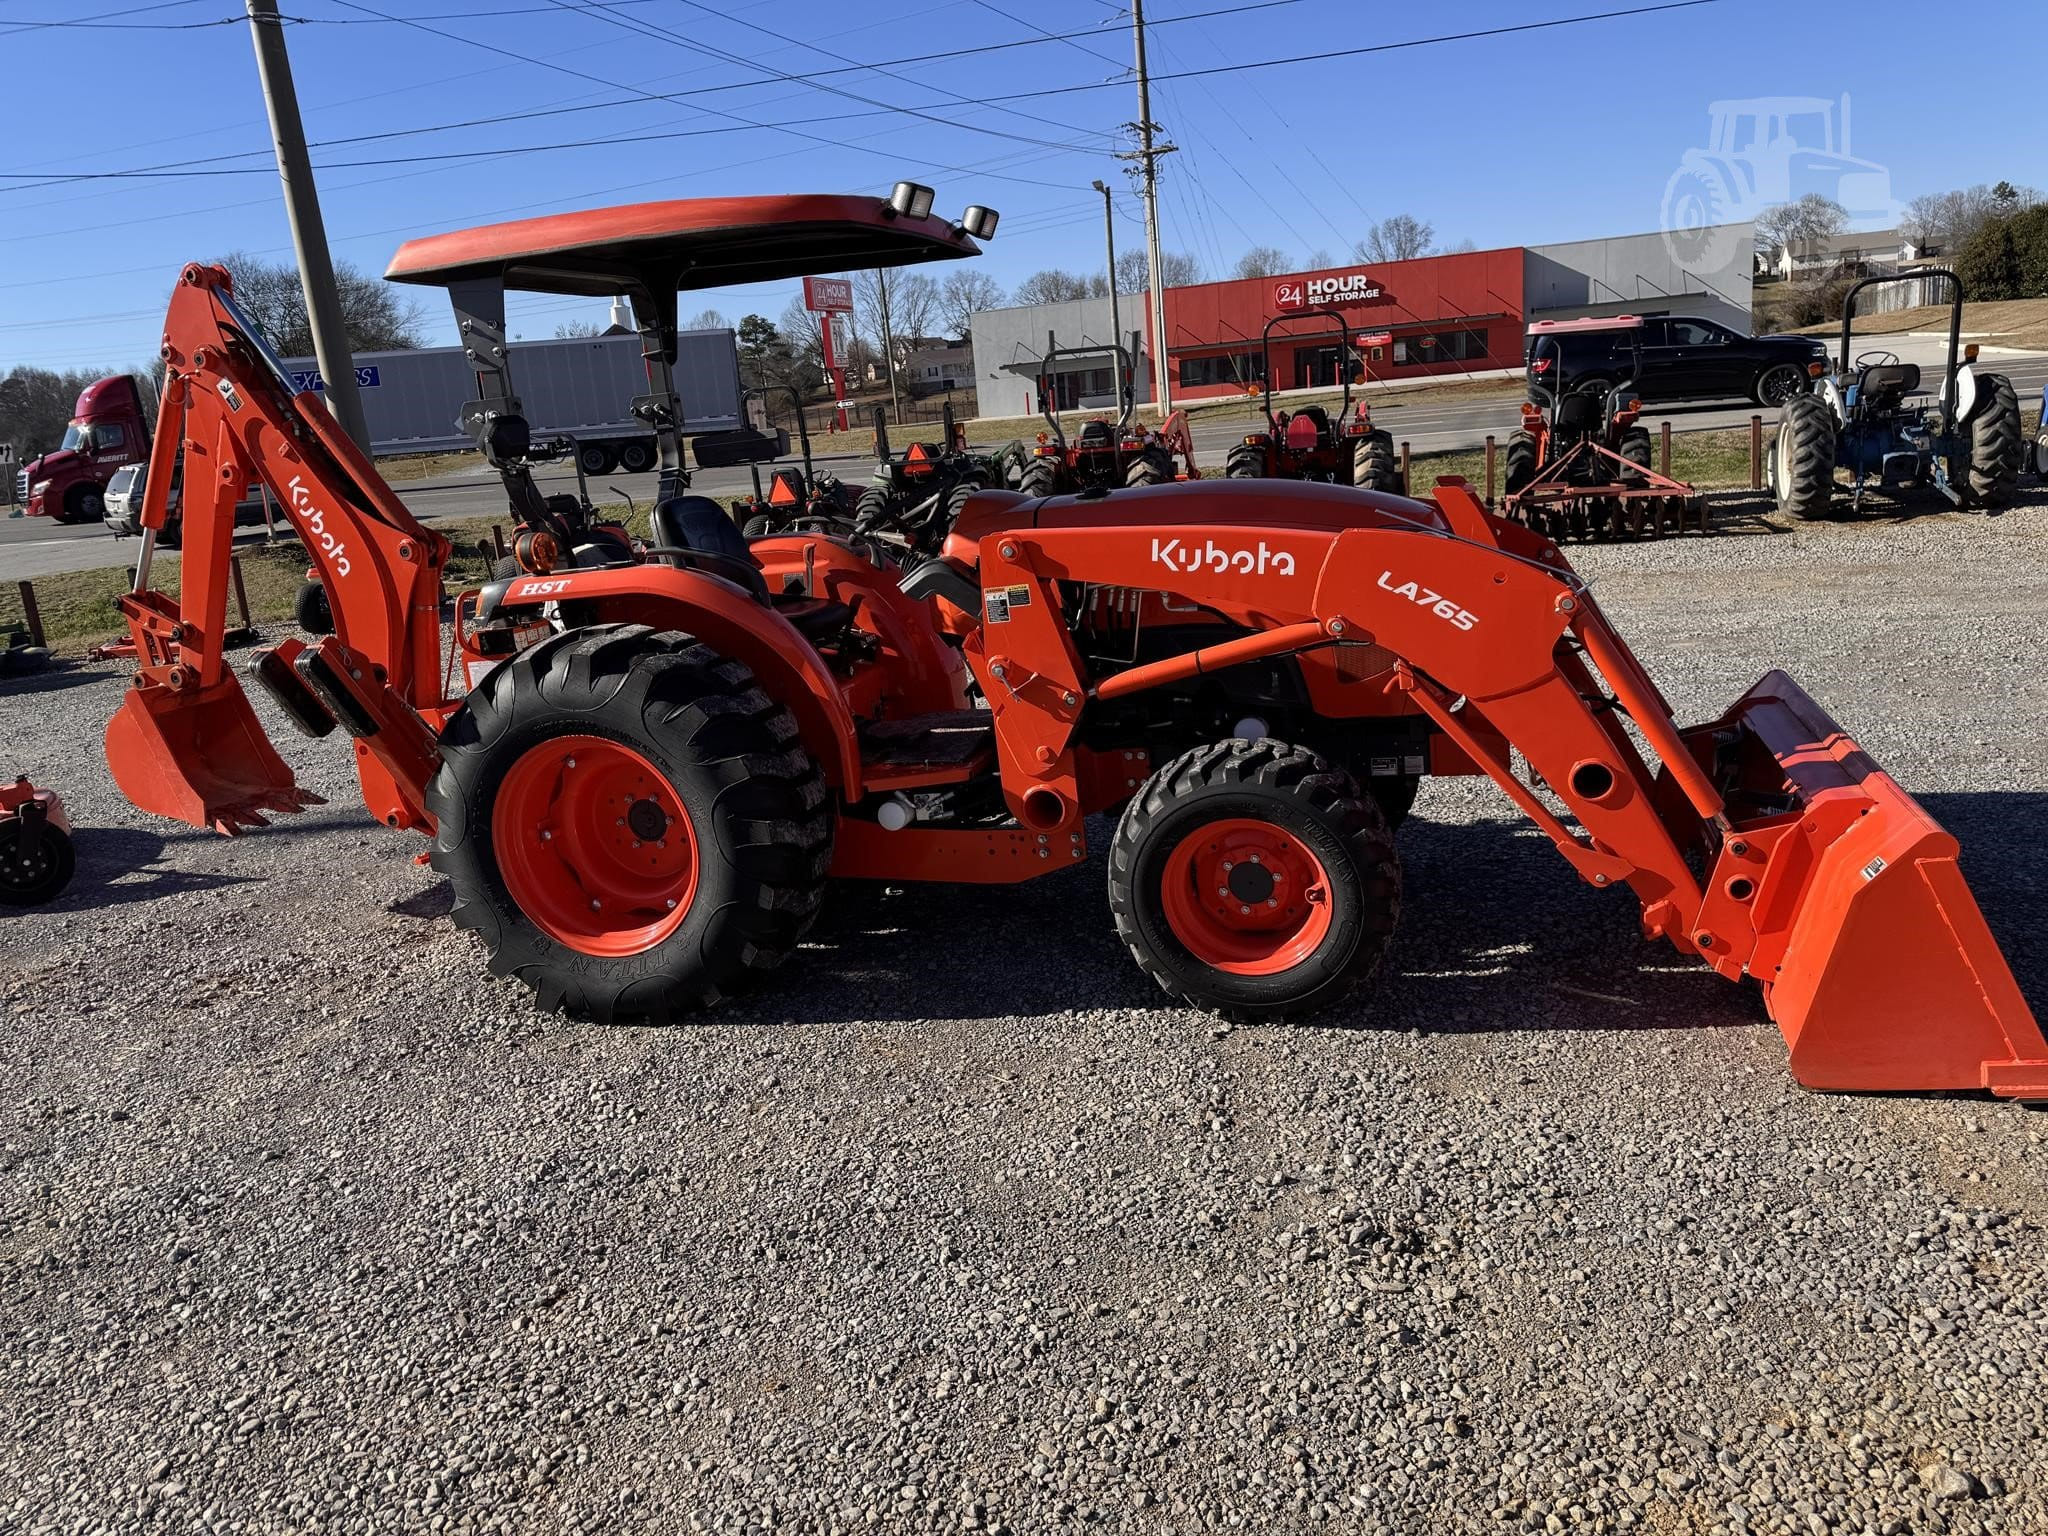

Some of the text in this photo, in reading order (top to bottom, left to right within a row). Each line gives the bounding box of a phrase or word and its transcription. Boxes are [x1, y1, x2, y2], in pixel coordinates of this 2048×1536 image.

[816, 284, 847, 304] 24 HOUR
[1280, 274, 1367, 306] 24 HOUR
[1308, 288, 1380, 305] SELF STORAGE
[292, 368, 373, 390] EXPS
[97, 453, 129, 463] AVERITT
[288, 475, 351, 577] Kubota
[1151, 538, 1295, 576] Kubota
[518, 580, 573, 596] HST
[1377, 570, 1480, 631] LA765
[567, 946, 671, 981] TITAN
